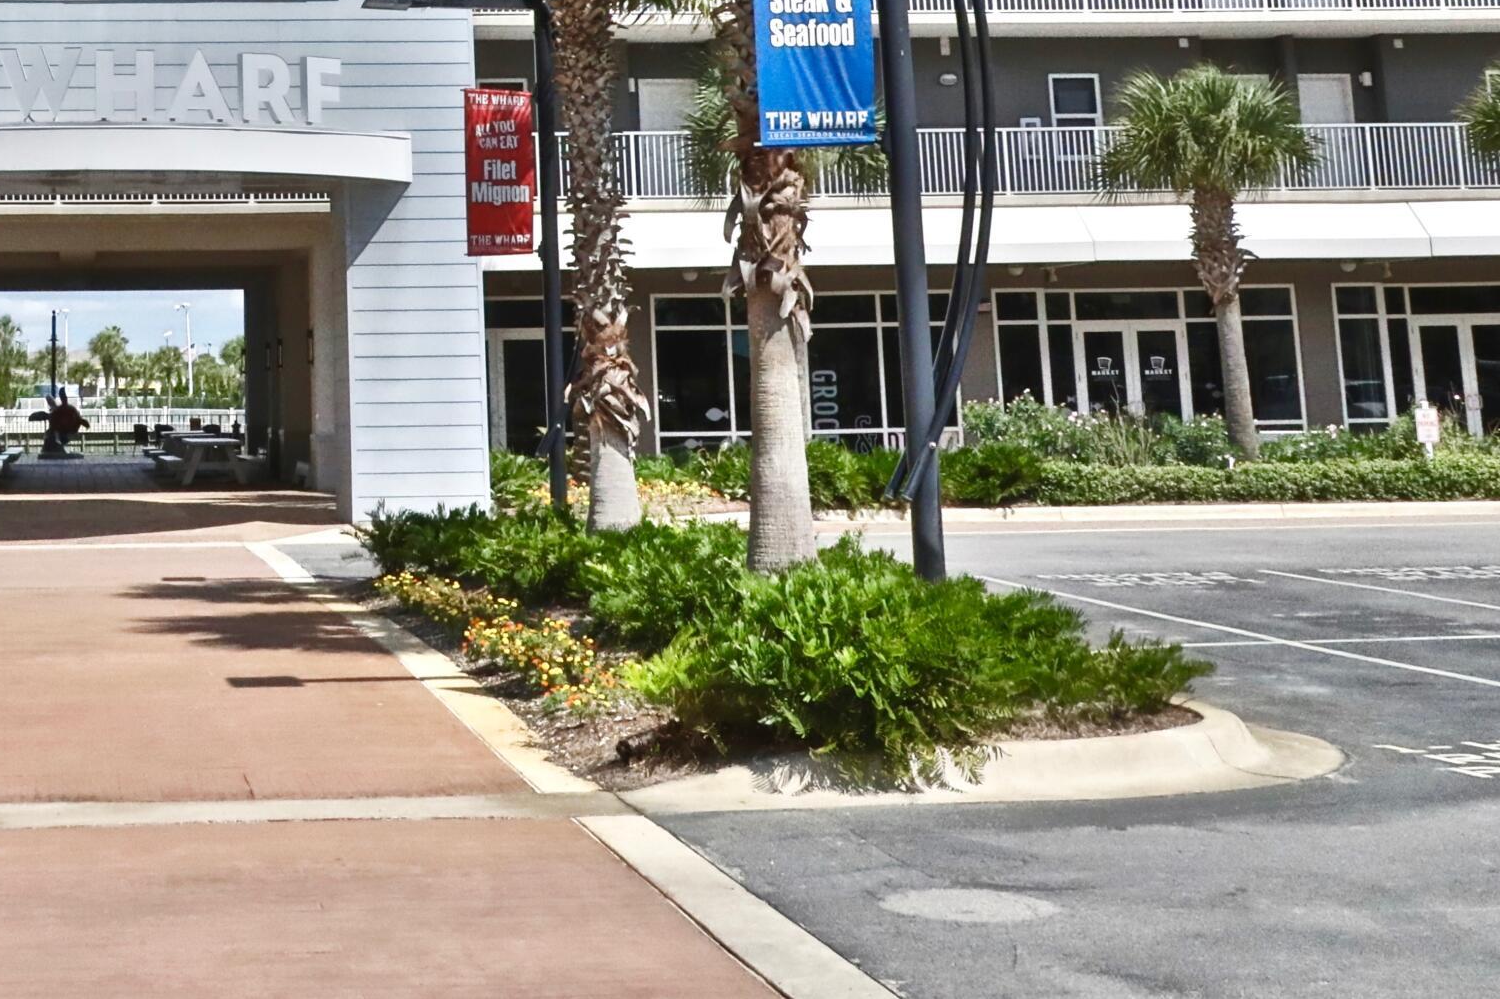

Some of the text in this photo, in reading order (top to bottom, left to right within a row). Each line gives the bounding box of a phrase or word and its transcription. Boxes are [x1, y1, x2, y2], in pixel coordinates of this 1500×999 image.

[769, 17, 855, 48] Seafood
[468, 93, 525, 106] THE WHARF
[475, 119, 516, 138] ALL YOU
[765, 110, 869, 131] THE WHARF
[479, 134, 519, 149] CAN EAT
[483, 159, 517, 181] Filet
[471, 181, 530, 206] Mignon
[470, 233, 531, 246] THE WHARF
